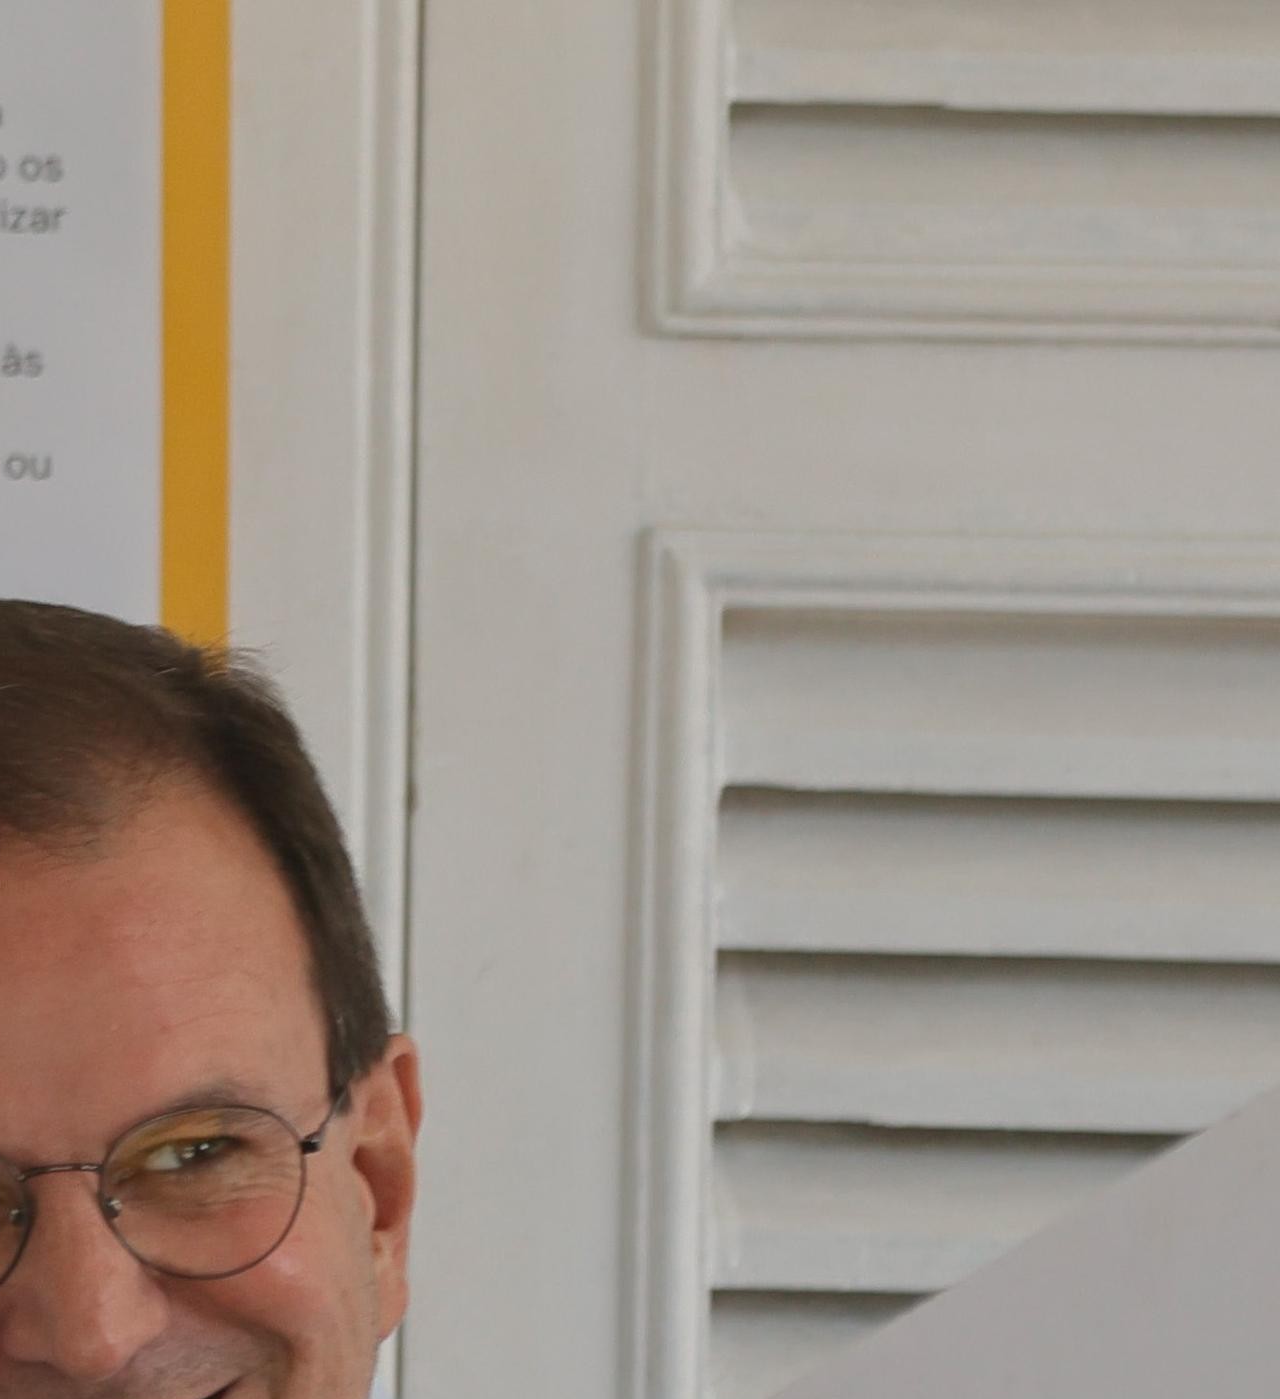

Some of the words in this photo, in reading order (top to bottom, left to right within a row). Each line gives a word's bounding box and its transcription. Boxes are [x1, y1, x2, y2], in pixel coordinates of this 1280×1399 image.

[17, 155, 64, 183] os
[0, 344, 44, 377] às
[3, 453, 52, 480] ou
